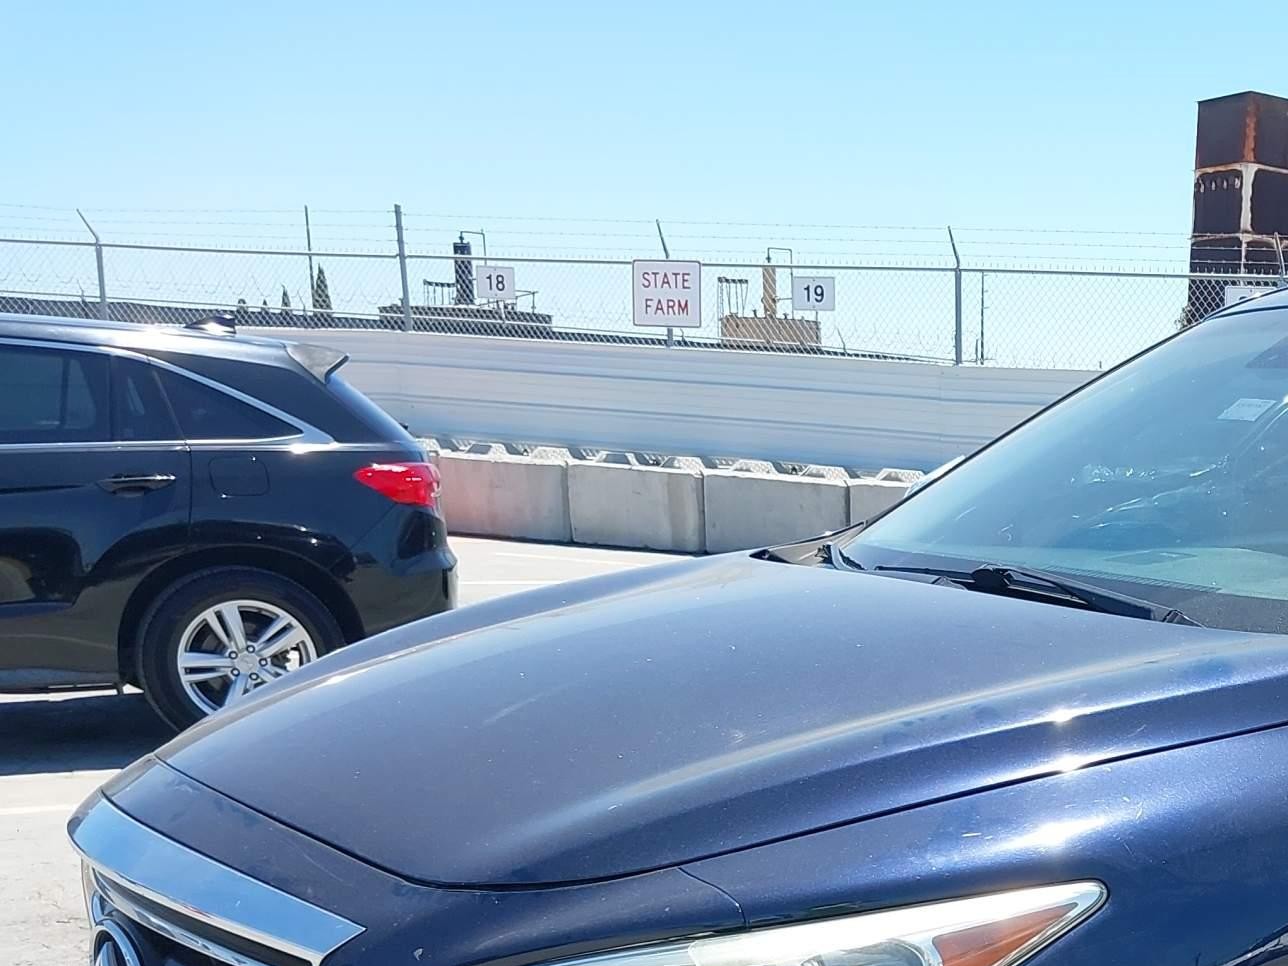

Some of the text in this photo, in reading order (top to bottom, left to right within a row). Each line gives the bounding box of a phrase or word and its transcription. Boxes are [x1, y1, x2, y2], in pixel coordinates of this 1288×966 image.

[486, 273, 506, 292] 18
[641, 271, 691, 289] STATE
[803, 284, 825, 304] 19
[644, 298, 689, 316] FARM
